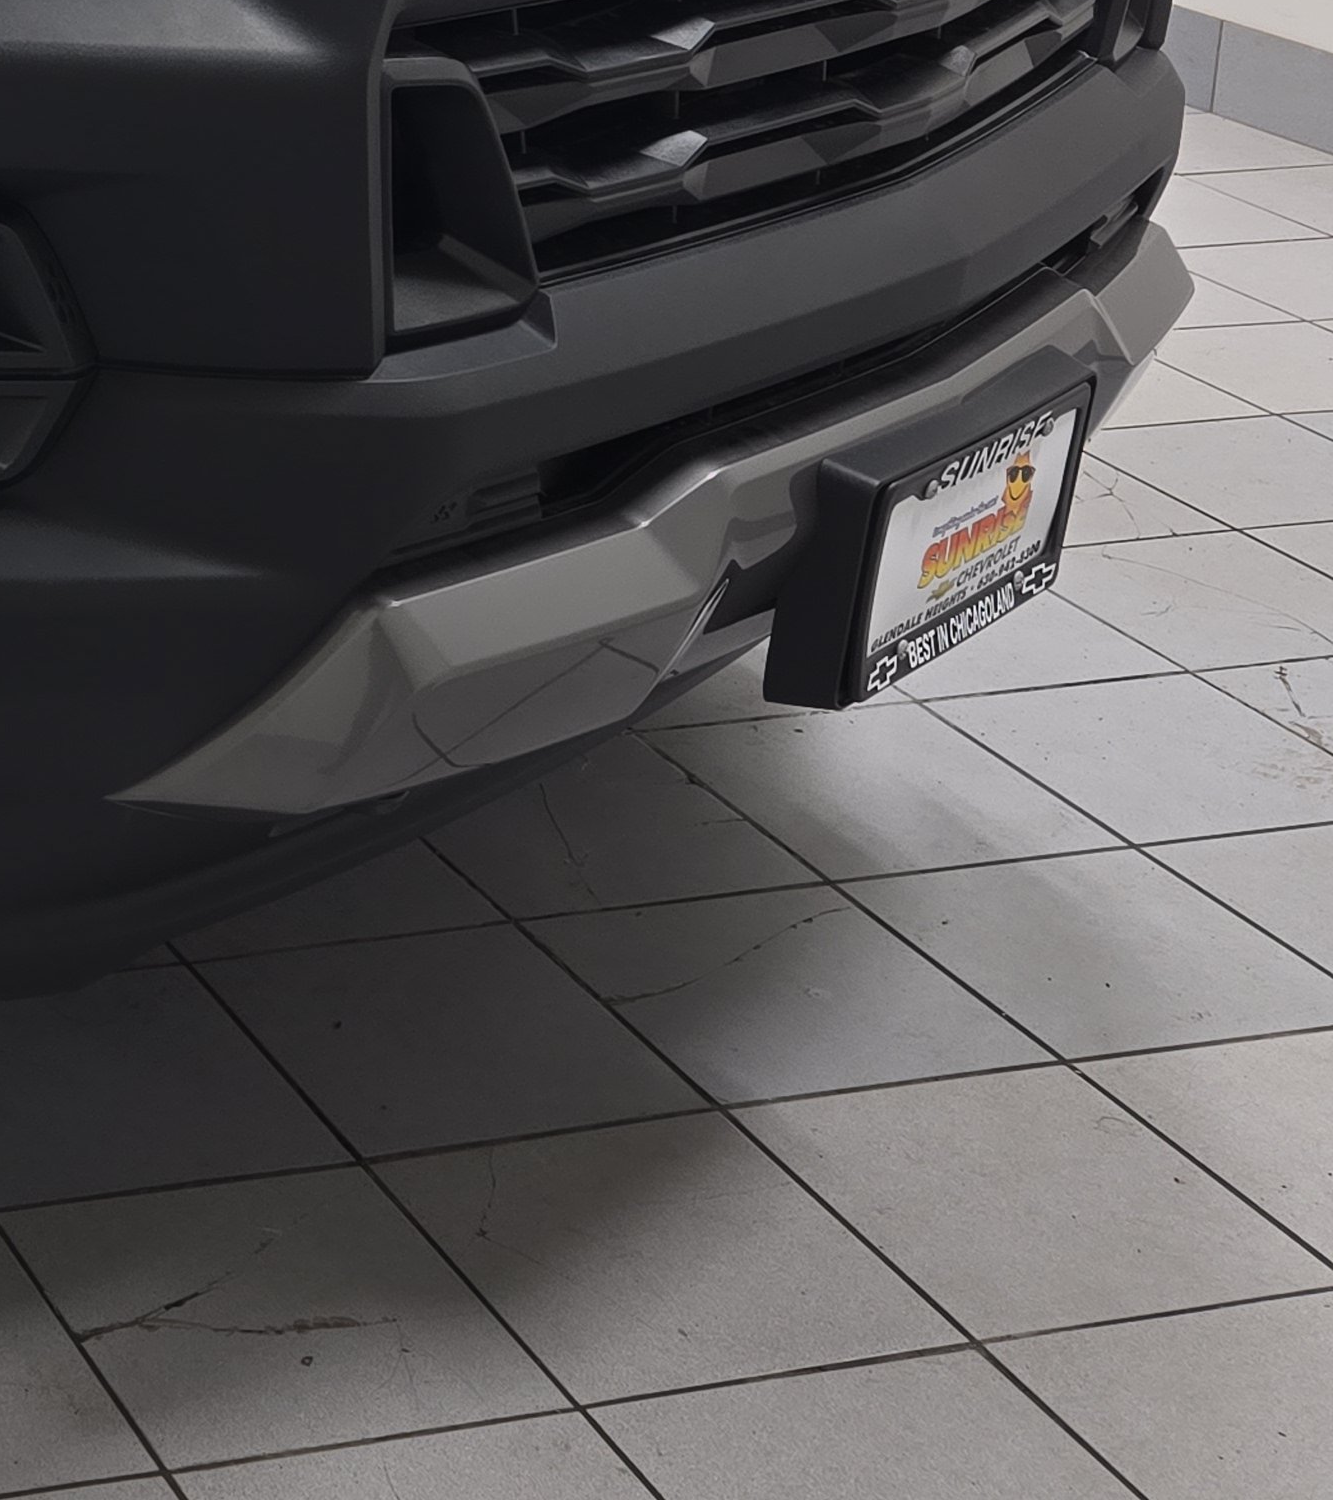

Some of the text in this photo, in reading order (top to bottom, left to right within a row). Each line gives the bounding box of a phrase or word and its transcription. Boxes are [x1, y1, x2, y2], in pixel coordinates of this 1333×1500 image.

[917, 495, 1032, 589] SUNRISE
[956, 535, 1021, 587] CHEVROLET
[871, 612, 924, 653] GLENDALE
[925, 586, 968, 621] HEIGHTS
[907, 581, 1015, 669] BEST IN CHICAGOLAND
